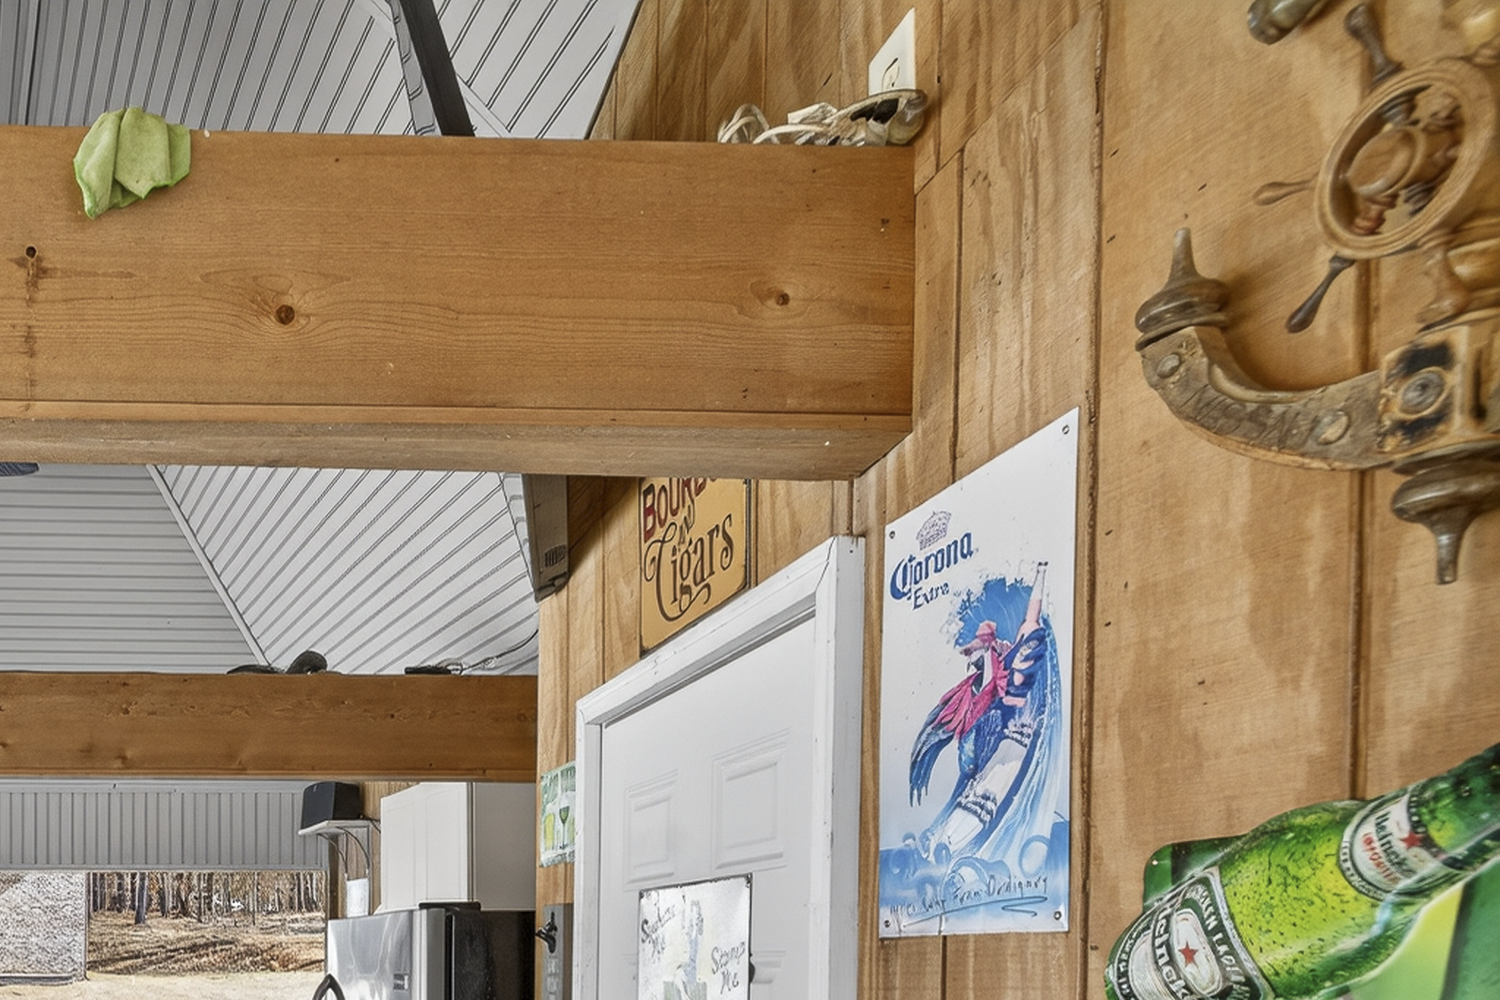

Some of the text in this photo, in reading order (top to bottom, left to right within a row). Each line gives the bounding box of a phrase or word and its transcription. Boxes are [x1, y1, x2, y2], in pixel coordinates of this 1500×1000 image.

[643, 477, 717, 543] BOUR
[643, 513, 734, 622] Cigars
[890, 533, 974, 601] Corona
[912, 582, 950, 611] Extra
